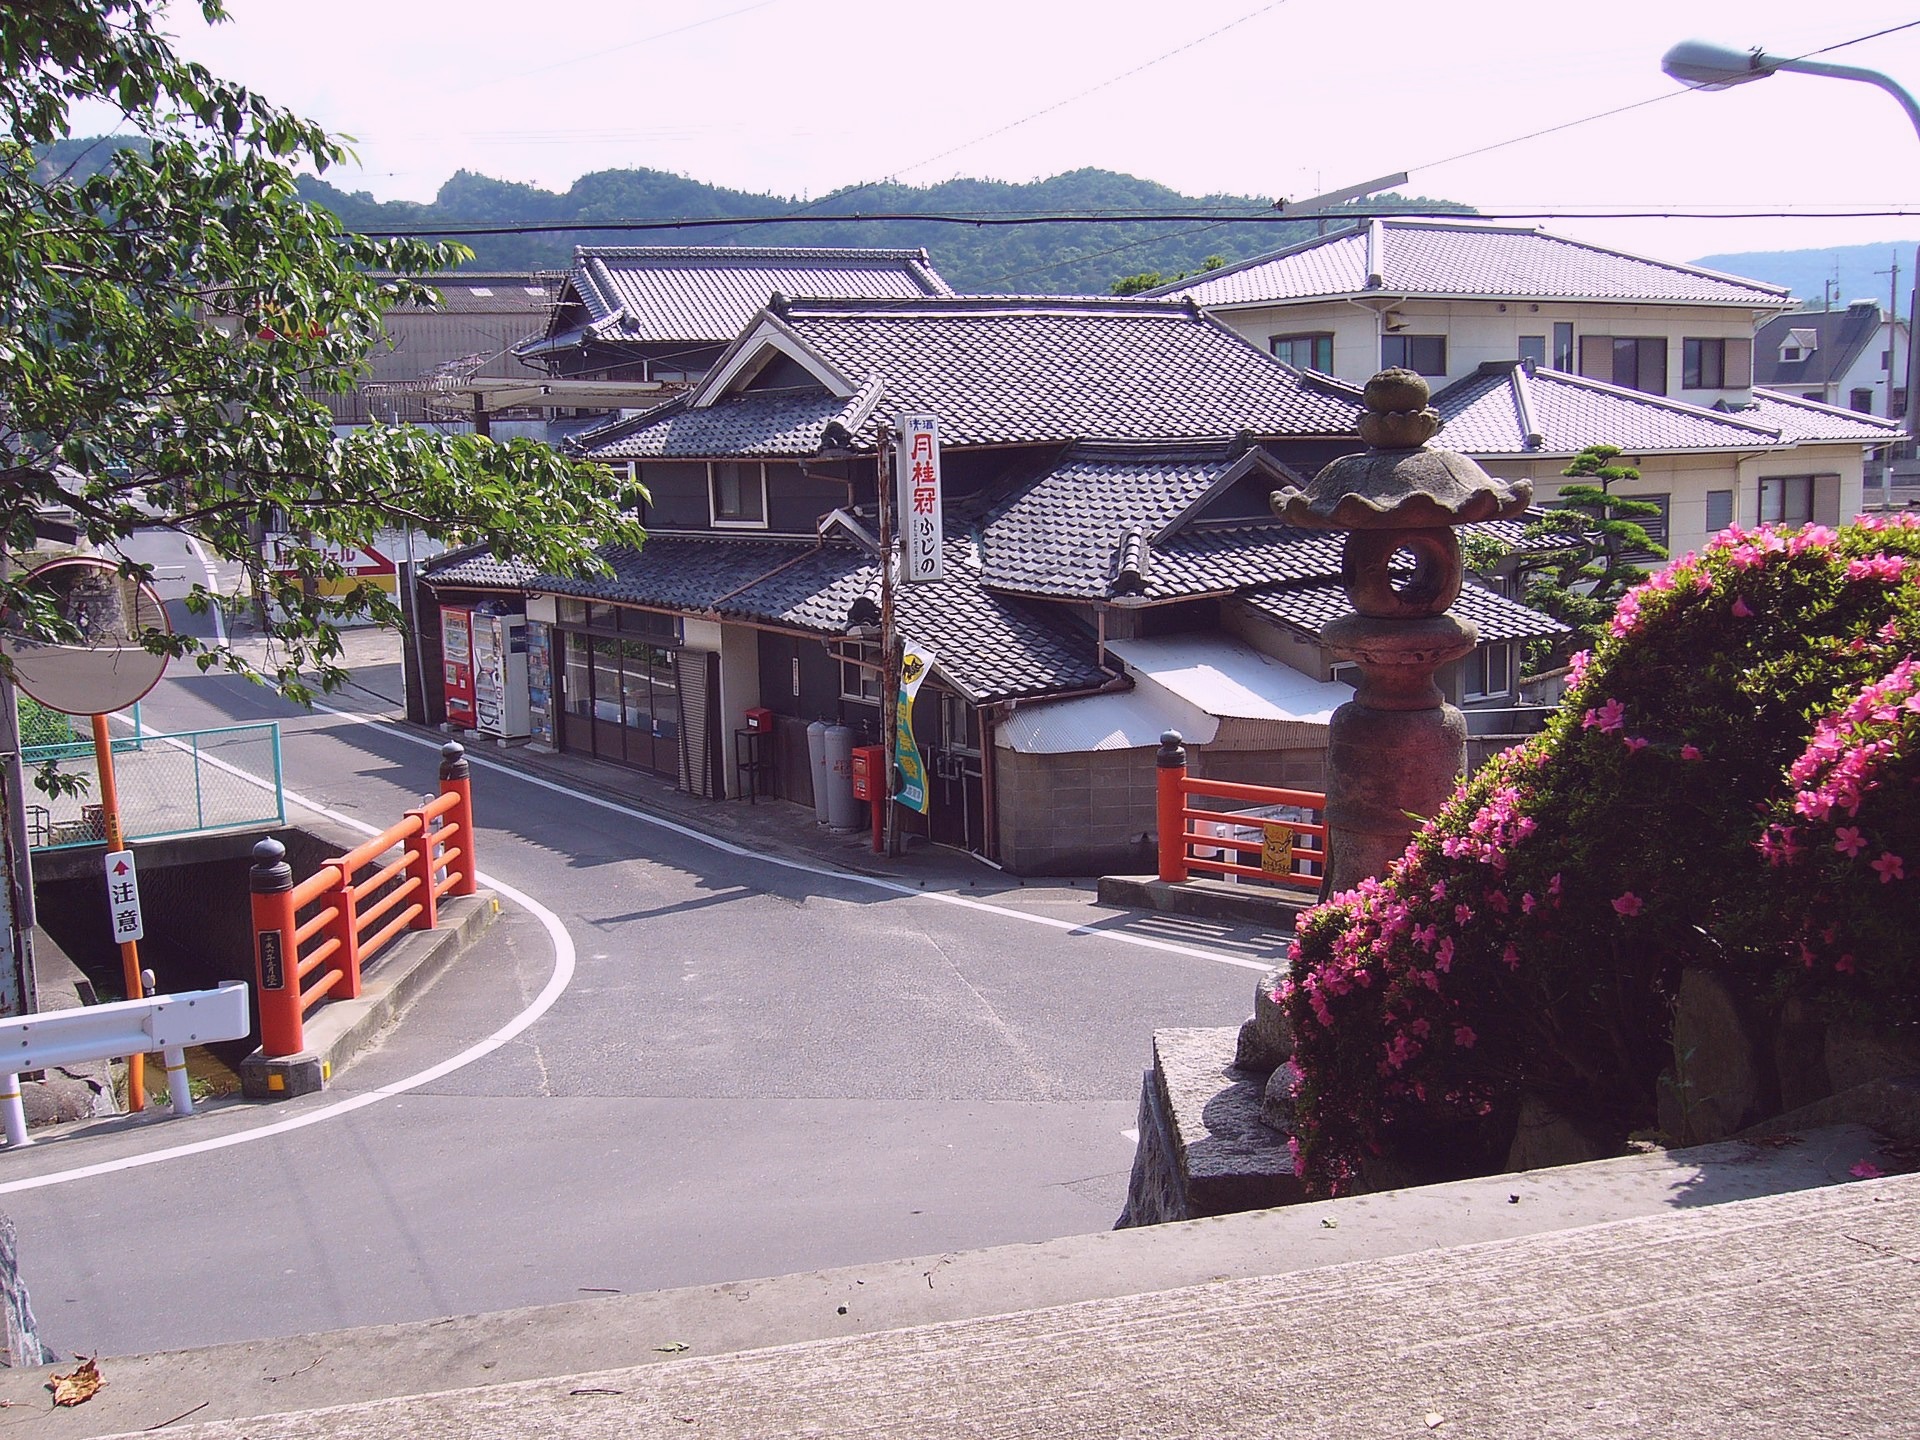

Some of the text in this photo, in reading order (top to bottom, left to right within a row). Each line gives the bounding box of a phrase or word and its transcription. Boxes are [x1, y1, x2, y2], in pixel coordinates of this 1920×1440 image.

[909, 418, 934, 431] 清酒
[911, 433, 936, 515] 月桂冠
[920, 517, 935, 573] ふじの
[112, 881, 138, 934] 注意
